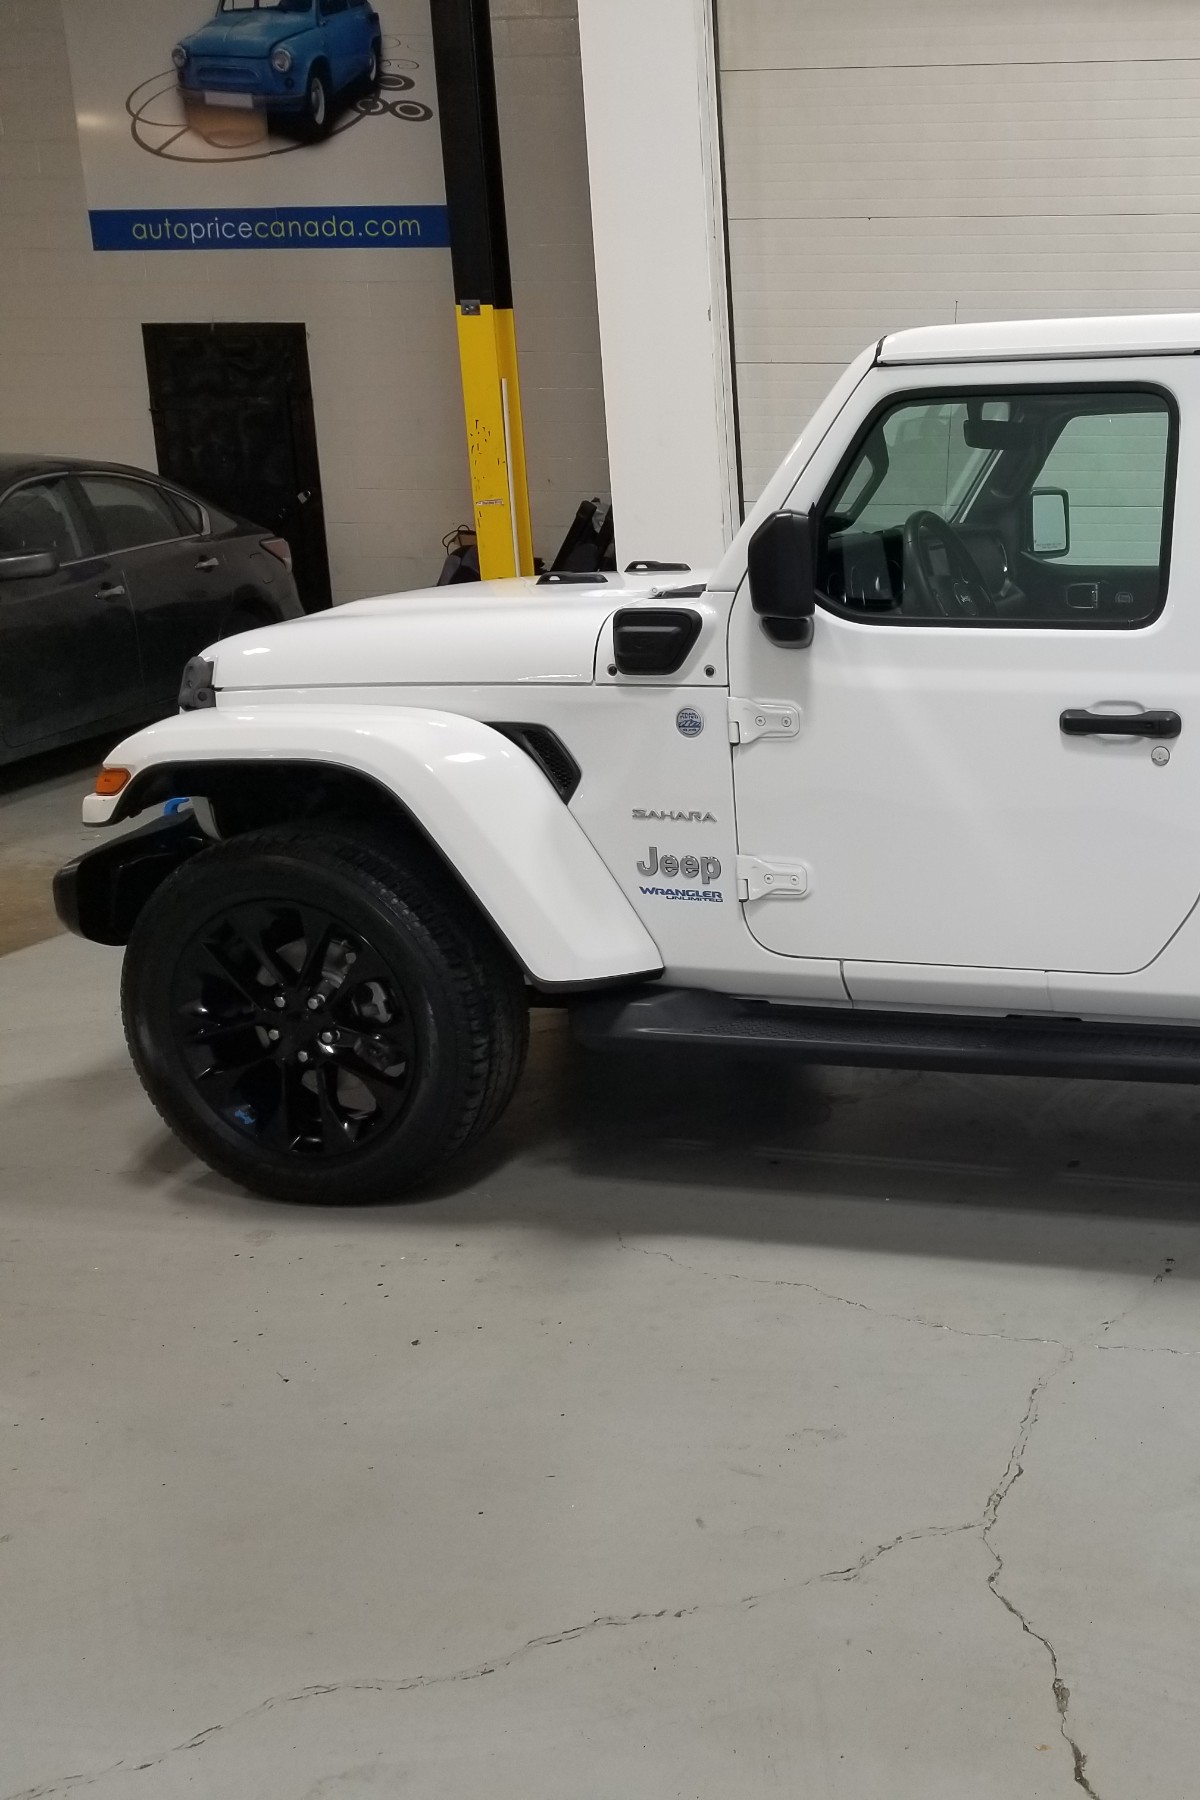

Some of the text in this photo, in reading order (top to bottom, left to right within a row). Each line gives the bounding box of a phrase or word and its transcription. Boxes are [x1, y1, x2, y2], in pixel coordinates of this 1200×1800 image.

[132, 215, 421, 243] autopricecanada.com
[632, 809, 717, 823] SAHARA
[636, 846, 722, 885] Jeep
[639, 886, 722, 898] WRANGLER
